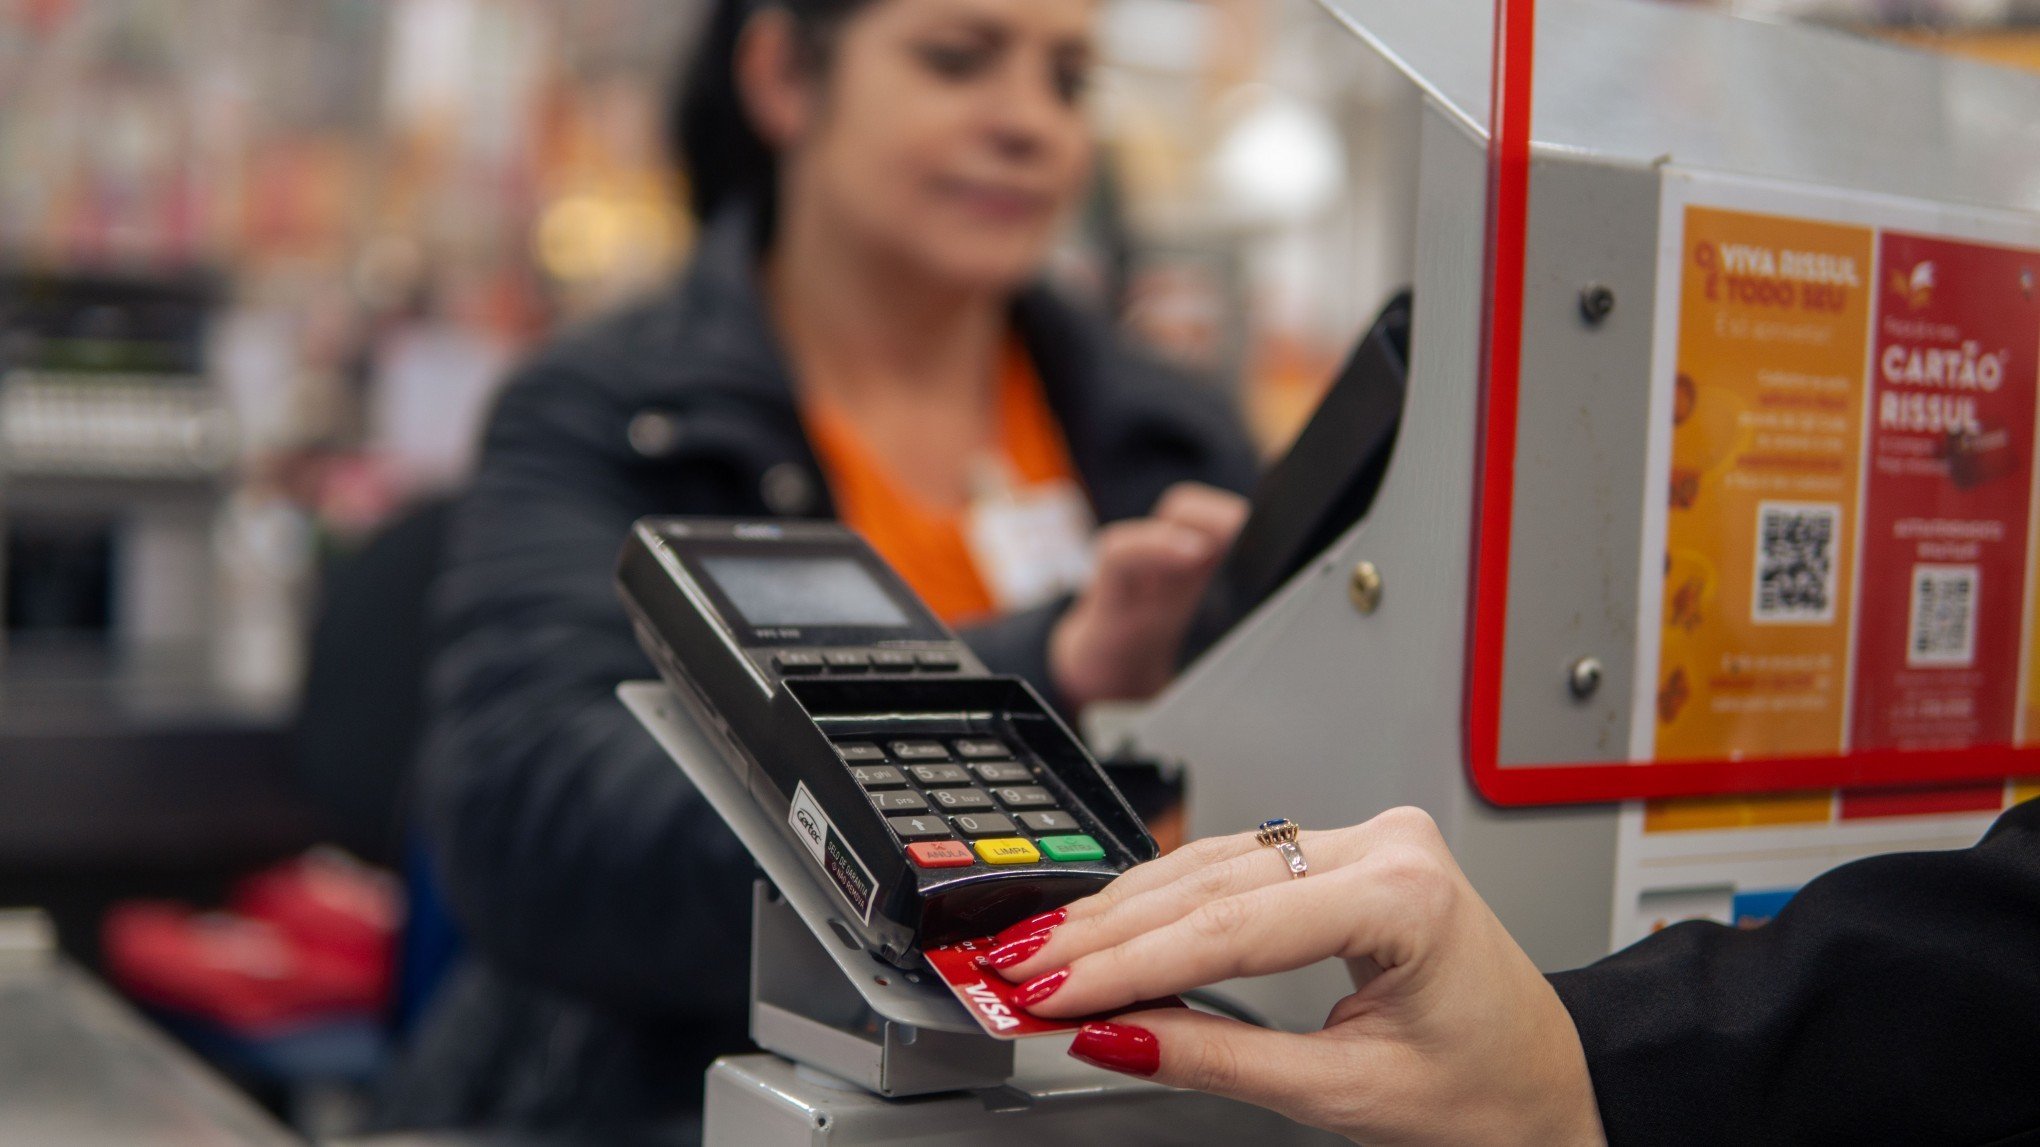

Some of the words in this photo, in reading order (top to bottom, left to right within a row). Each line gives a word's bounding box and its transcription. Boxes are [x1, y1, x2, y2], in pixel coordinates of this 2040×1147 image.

[1720, 243, 1776, 275] VIVA
[1780, 250, 1860, 287] RISSUL
[1726, 274, 1794, 307] TODO
[1882, 340, 2003, 392] CARTÃO
[1880, 390, 1982, 436] RISSUL
[894, 743, 914, 756] 2
[855, 768, 870, 781] 4
[873, 769, 893, 780] ghi
[916, 766, 934, 779] 5
[981, 764, 1000, 778] 6
[871, 793, 886, 807] 7
[895, 797, 915, 806] prs
[938, 791, 957, 804] 8
[1003, 788, 1022, 802] 9
[960, 816, 979, 830] 0
[927, 850, 968, 859] ANULA
[993, 847, 1031, 856] LIMPA
[828, 841, 841, 860] SELO
[839, 856, 848, 869] DE
[845, 865, 868, 899] GARANTIA
[836, 868, 847, 885] NÃO
[846, 881, 865, 910] REMOVA
[965, 979, 1021, 1031] VISA
